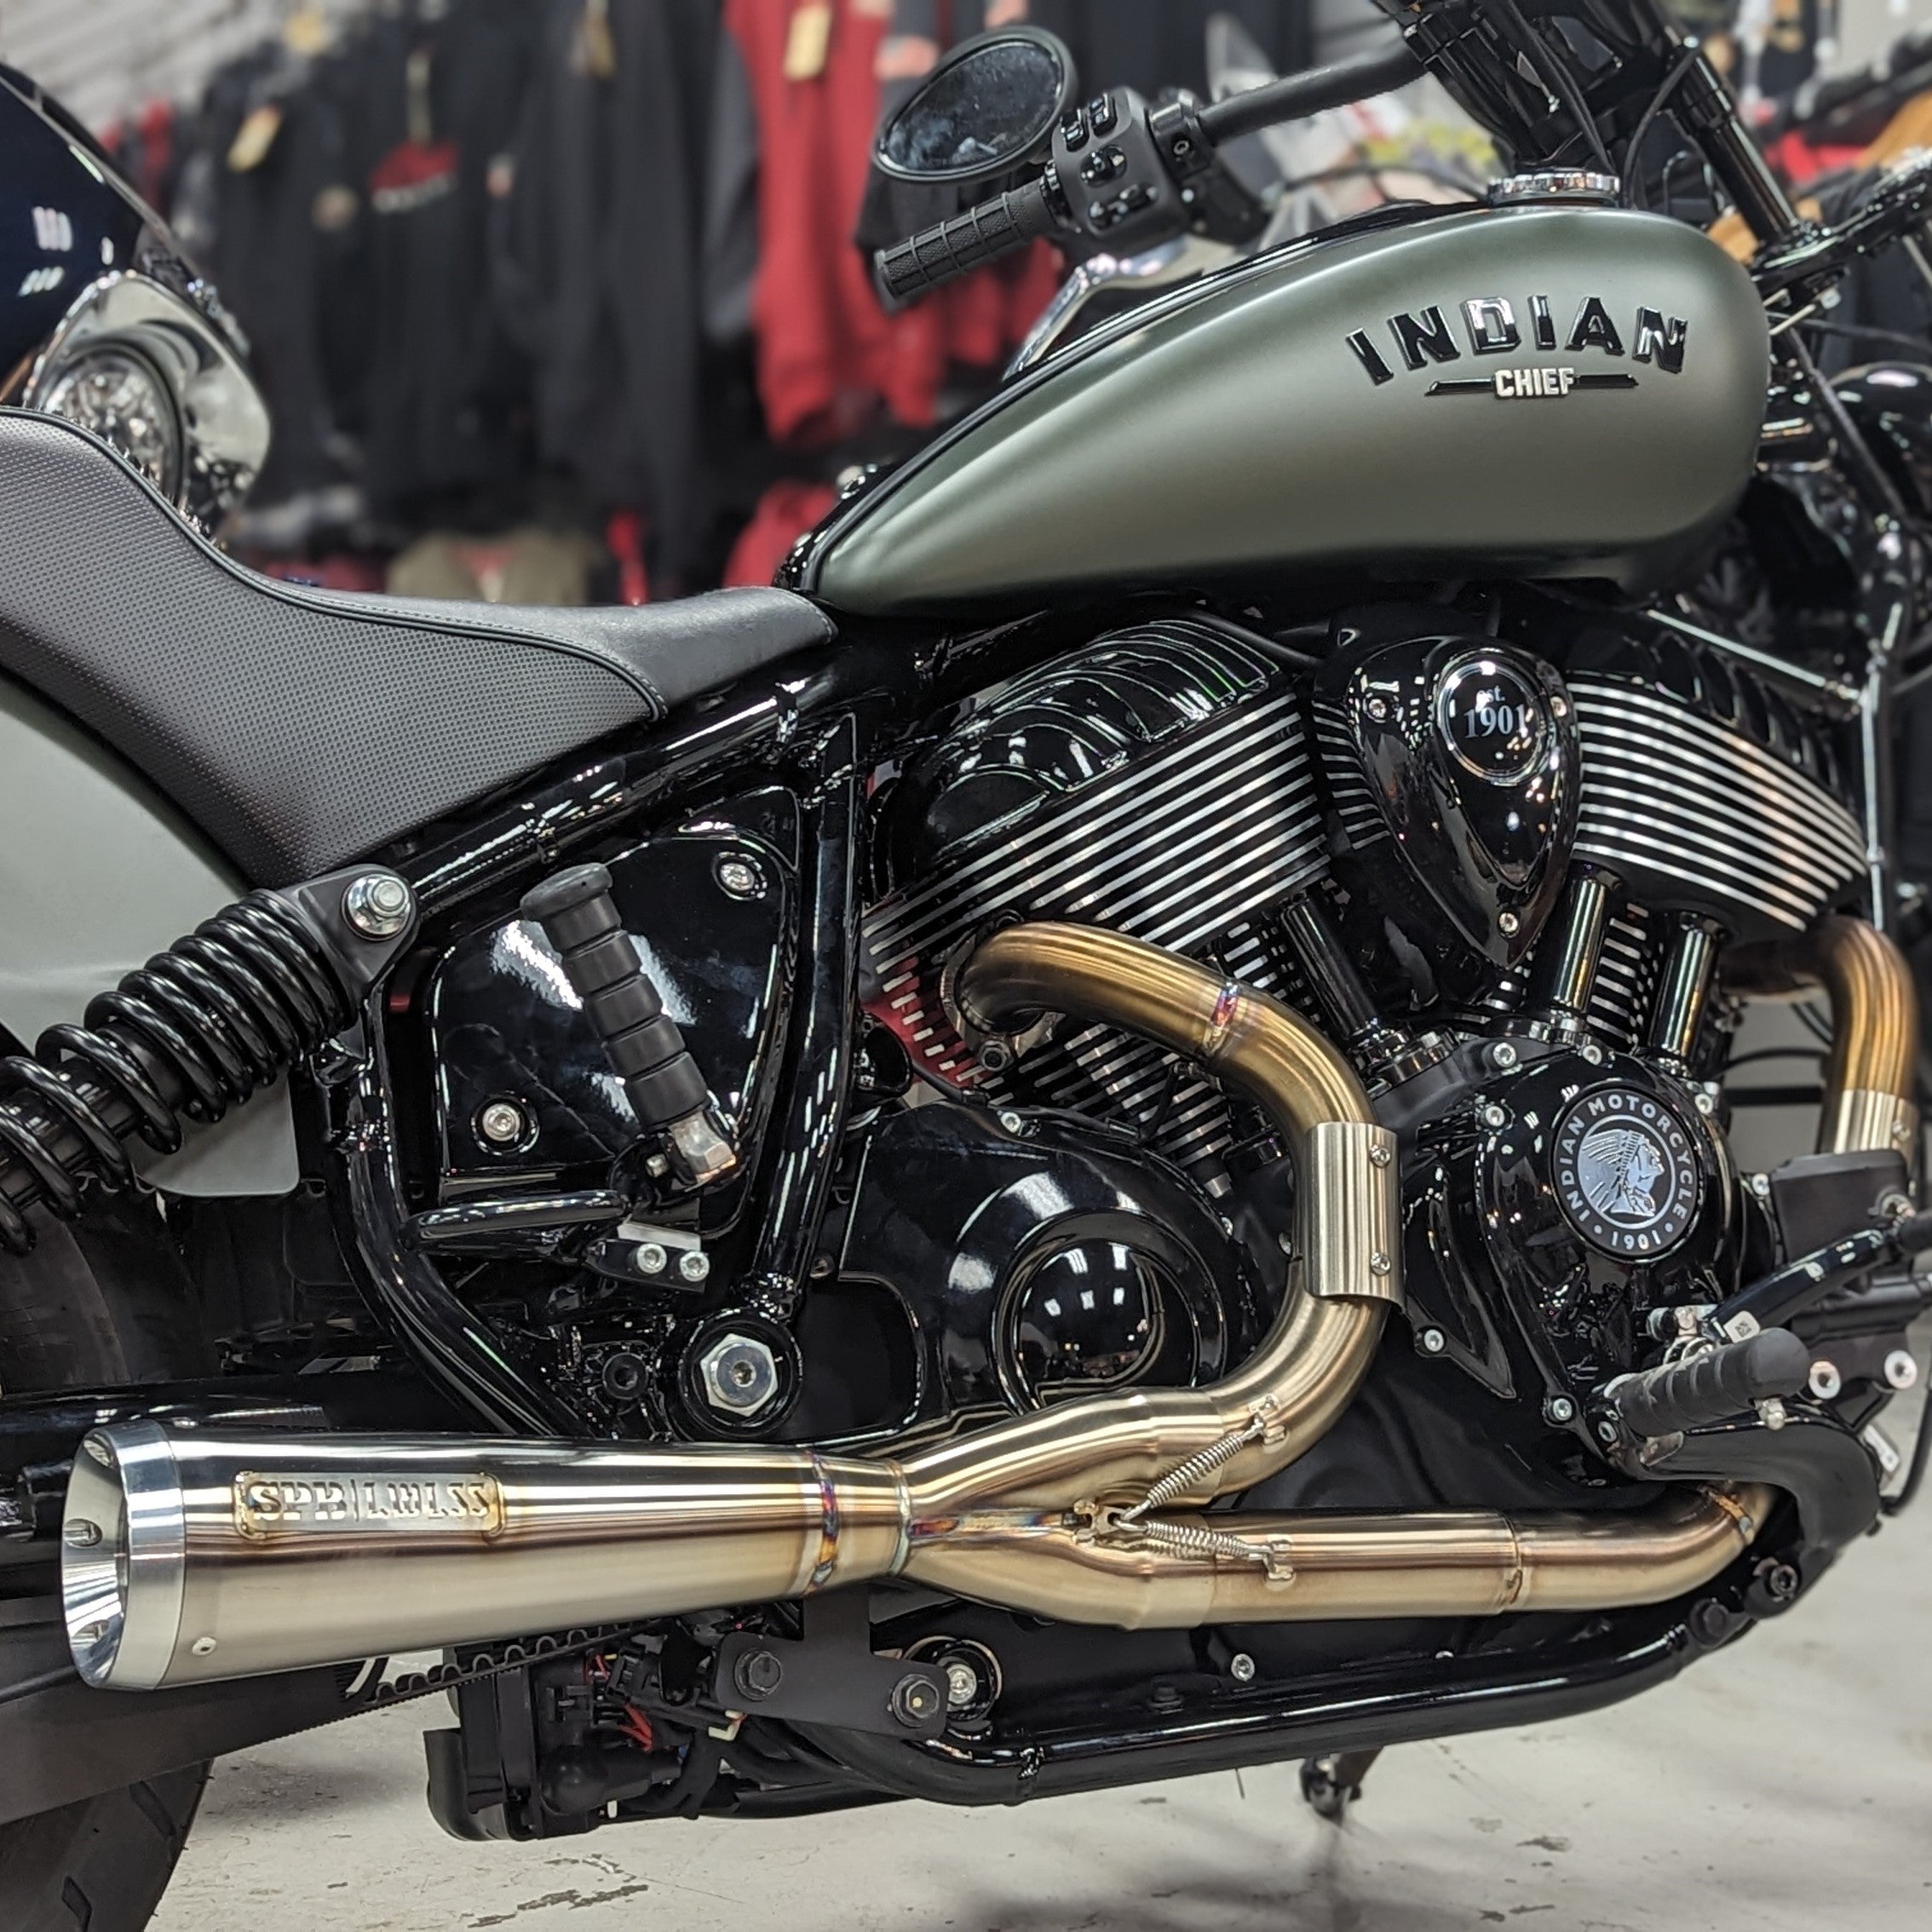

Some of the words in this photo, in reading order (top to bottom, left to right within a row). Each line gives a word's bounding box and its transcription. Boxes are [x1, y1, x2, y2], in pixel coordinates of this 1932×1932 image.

[1346, 295, 1689, 385] INDIAN
[1494, 368, 1574, 397] CHIEF
[1464, 704, 1527, 739] 1901
[1560, 1116, 1590, 1222] INDIAN
[1588, 1095, 1693, 1219] MOTORCYCLE
[1612, 1231, 1661, 1250] 1901
